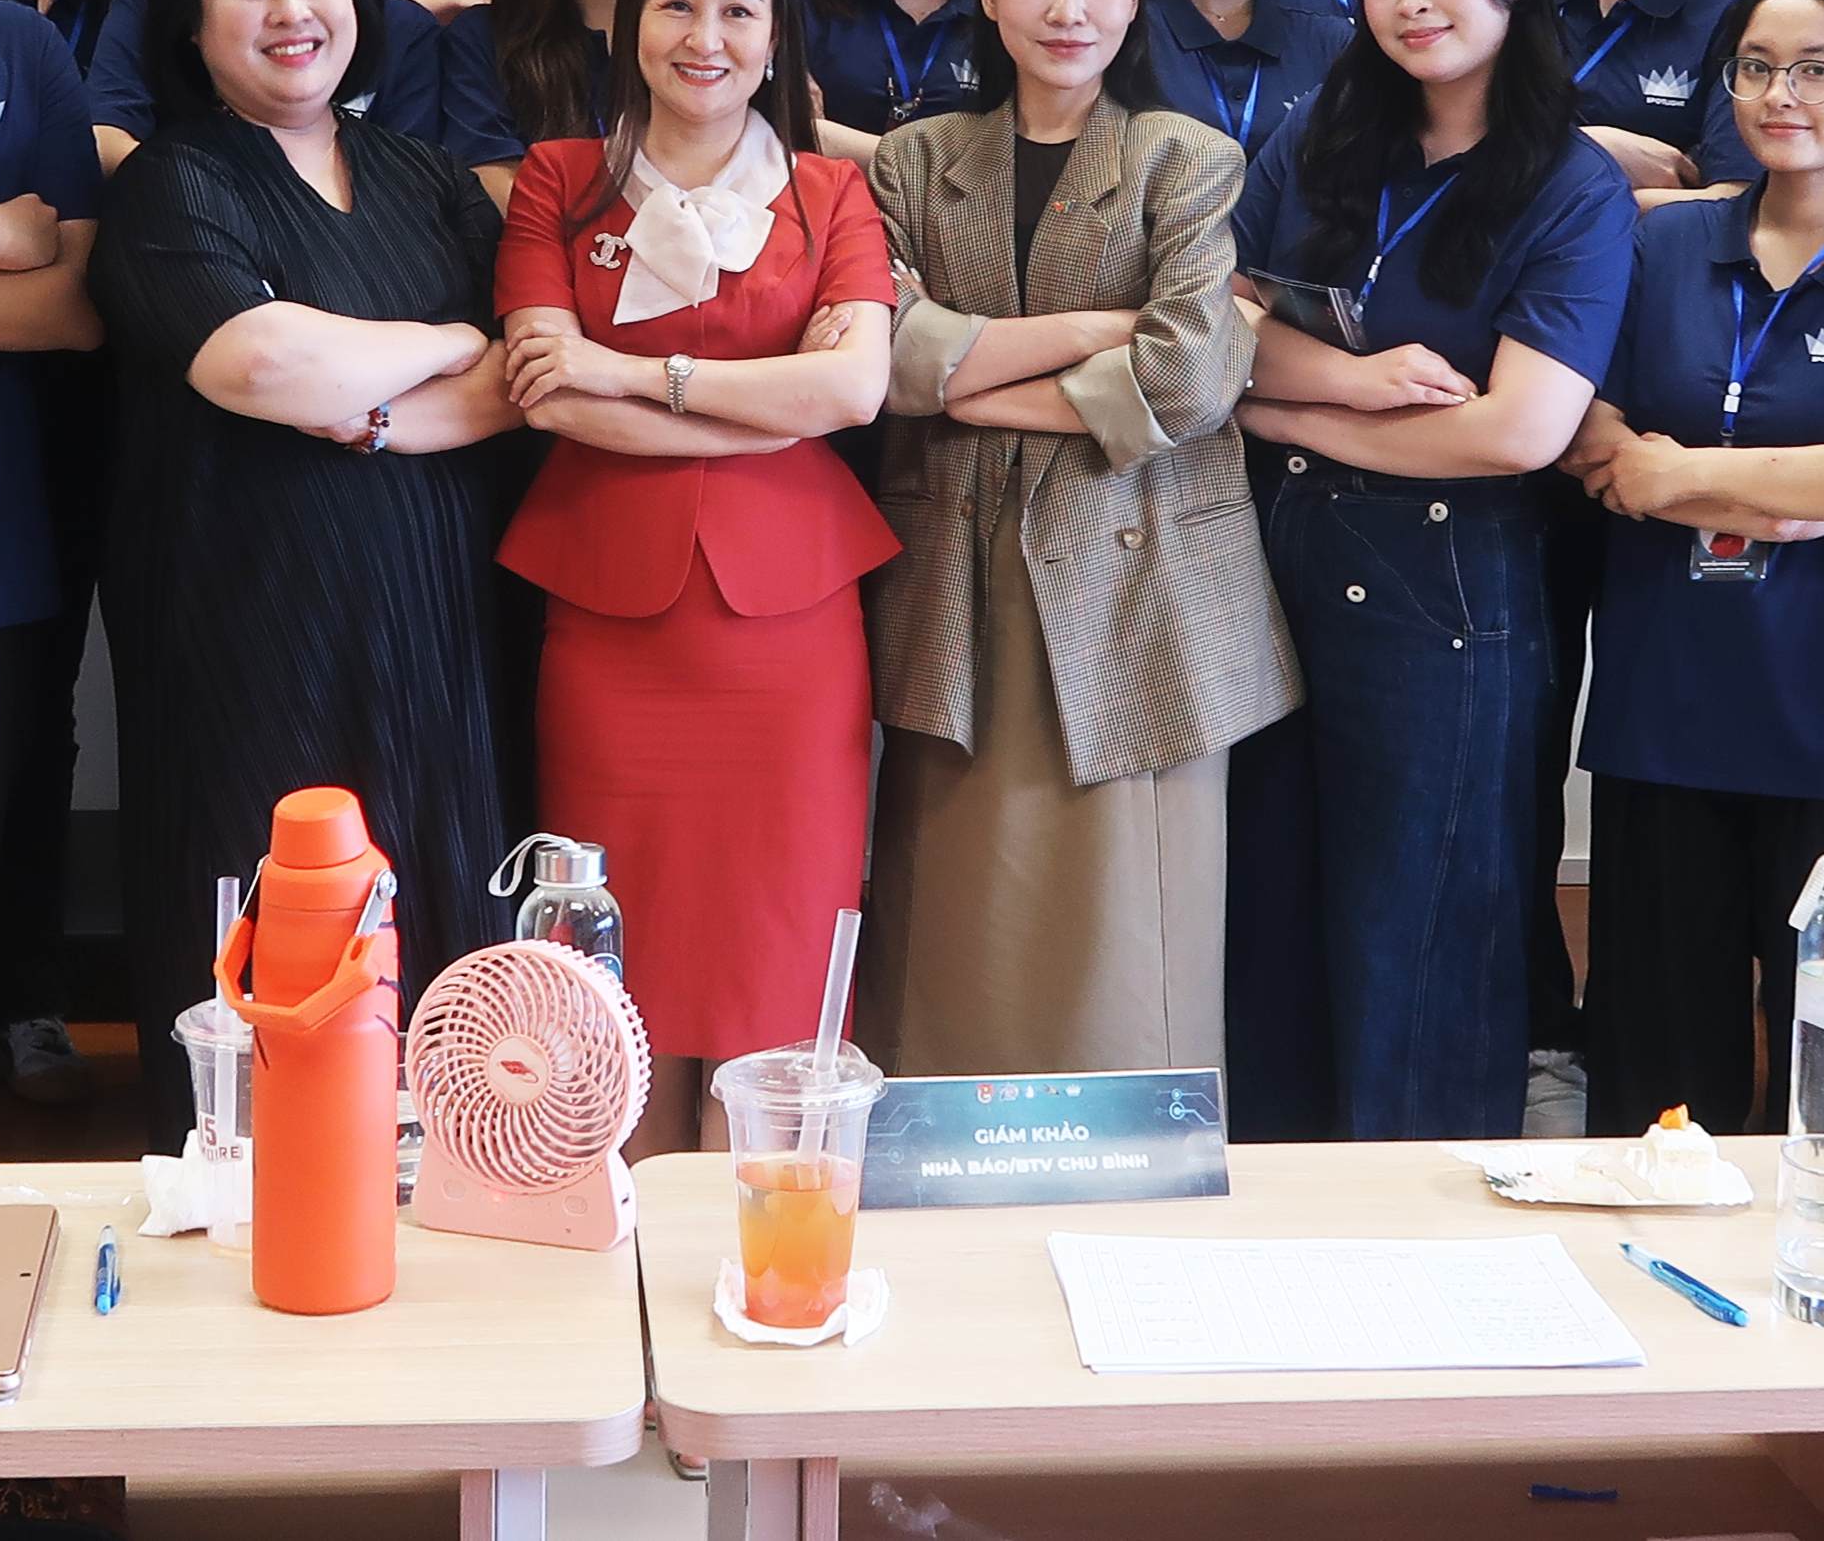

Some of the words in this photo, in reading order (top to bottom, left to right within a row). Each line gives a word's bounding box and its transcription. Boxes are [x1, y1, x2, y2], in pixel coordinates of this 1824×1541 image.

[973, 1124, 1027, 1145] GIÁM
[920, 1157, 965, 1178] NHÀ
[966, 1156, 1055, 1177] BÁO/BTV
[1057, 1155, 1098, 1173] CHU
[1101, 1152, 1151, 1170] BÌNH
